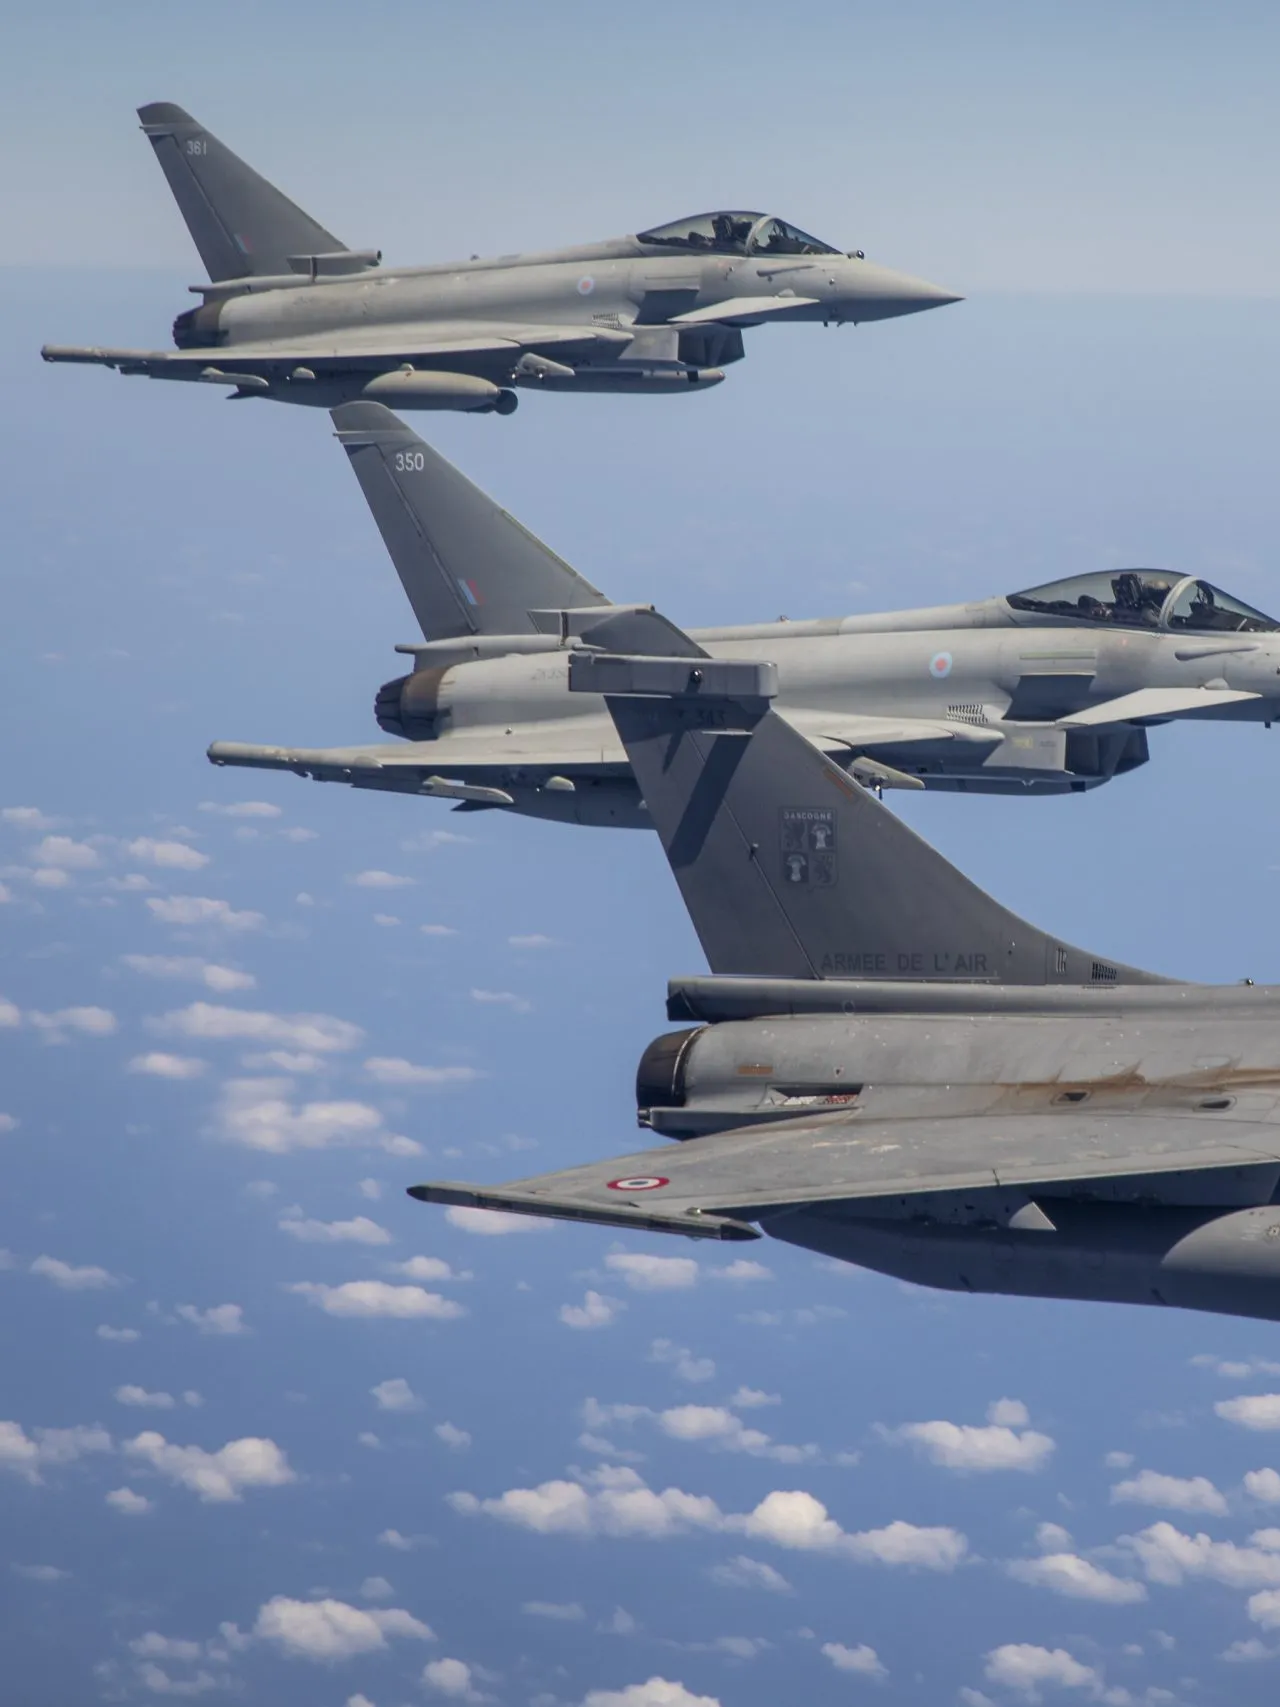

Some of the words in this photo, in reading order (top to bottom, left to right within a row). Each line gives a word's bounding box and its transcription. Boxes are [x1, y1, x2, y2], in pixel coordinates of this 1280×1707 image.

[186, 140, 207, 156] 361
[395, 452, 424, 471] 350
[820, 953, 887, 972] ARMEE
[897, 953, 924, 972] DE
[933, 953, 988, 972] L'AIR
